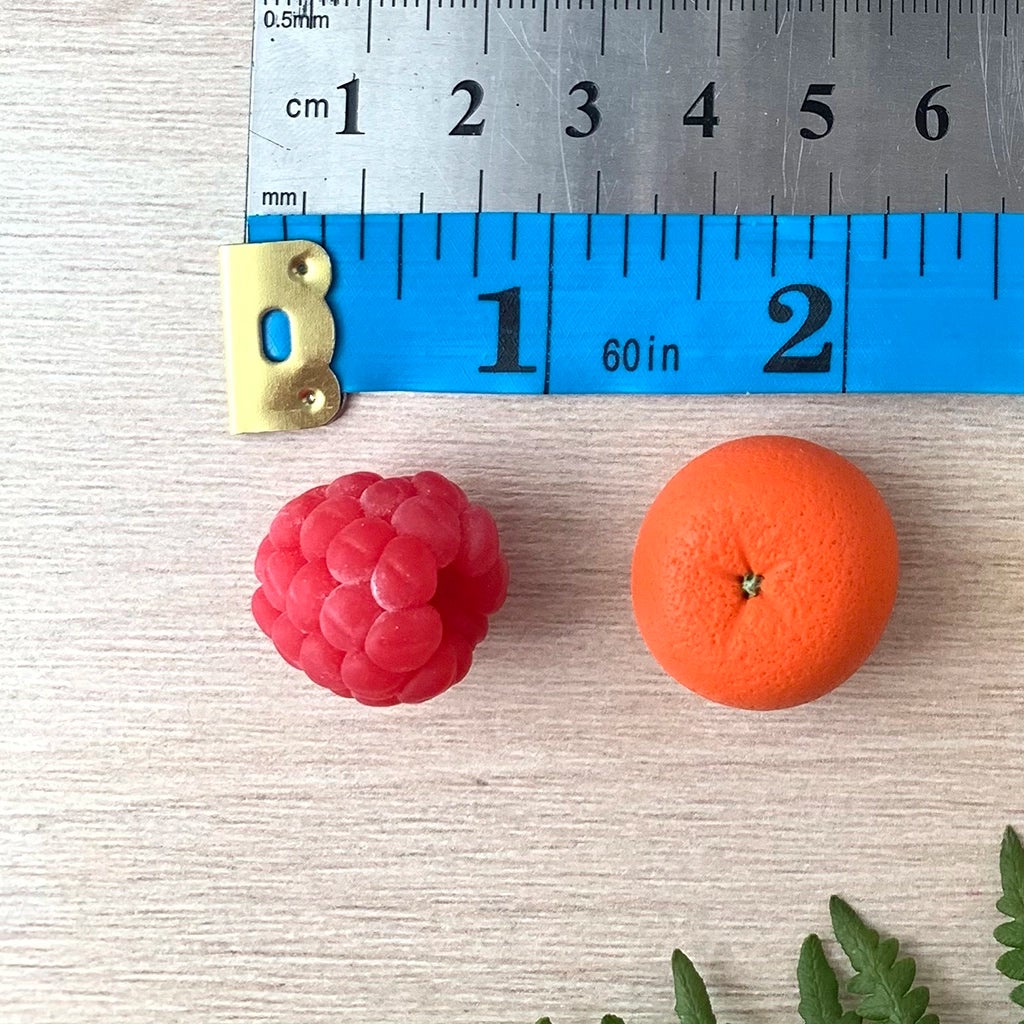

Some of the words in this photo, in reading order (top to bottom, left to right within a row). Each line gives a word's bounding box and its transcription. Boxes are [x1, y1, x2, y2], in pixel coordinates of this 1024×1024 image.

[263, 11, 330, 29] 0.5mm
[285, 95, 329, 118] cm
[335, 78, 365, 135] 1
[448, 79, 486, 137] 2
[565, 80, 602, 139] 3
[682, 82, 720, 139] 4
[799, 83, 836, 140] 5
[914, 84, 952, 142] 6
[261, 189, 297, 206] mm
[477, 285, 538, 374] 1
[602, 337, 681, 373] 60in
[762, 283, 834, 373] 2
